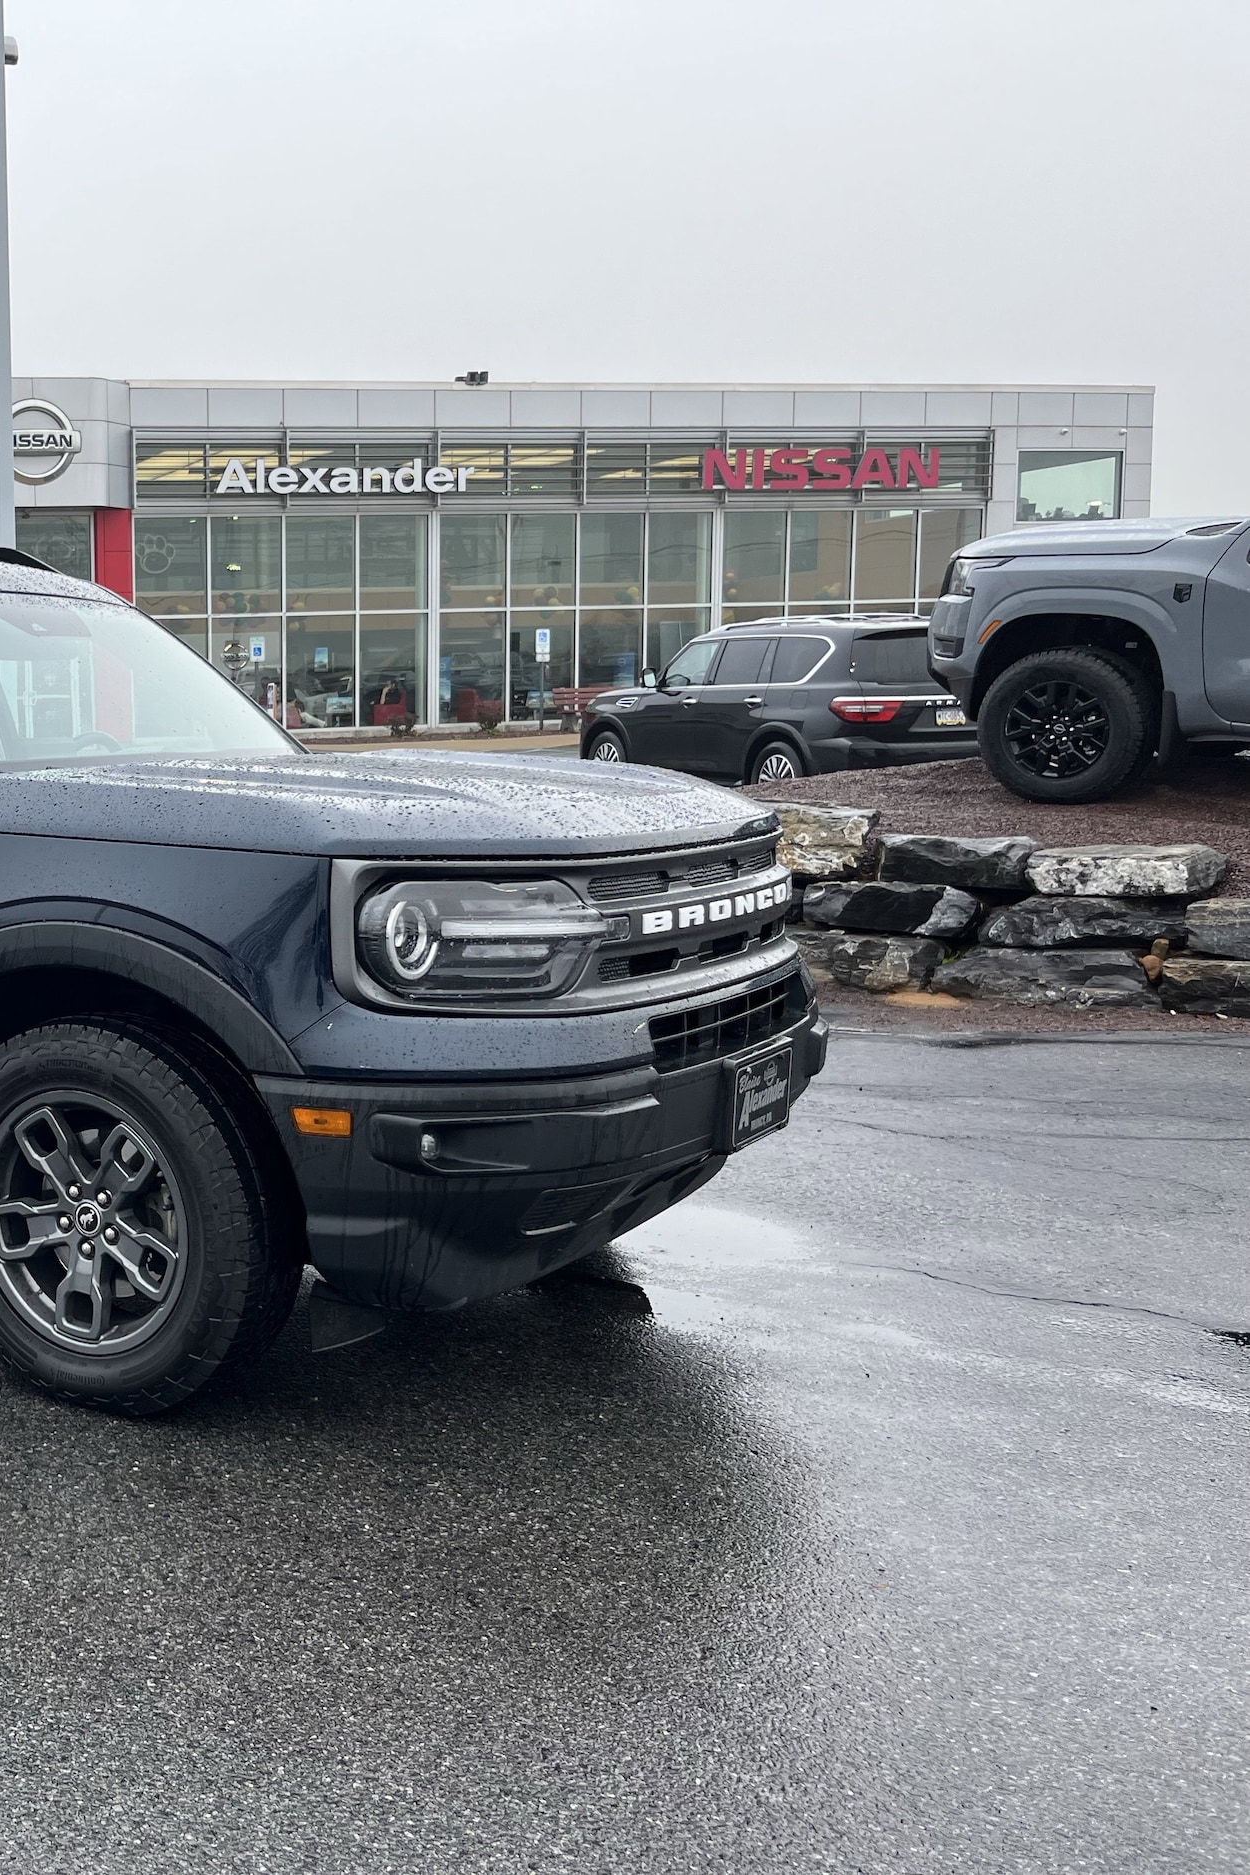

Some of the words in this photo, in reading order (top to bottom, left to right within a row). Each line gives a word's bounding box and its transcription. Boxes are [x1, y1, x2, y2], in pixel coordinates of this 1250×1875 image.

[13, 434, 78, 448] ISSAN
[216, 458, 475, 494] Alexander
[702, 448, 940, 489] NISSAN
[642, 882, 787, 934] BRONCO
[738, 1078, 787, 1131] Alexander
